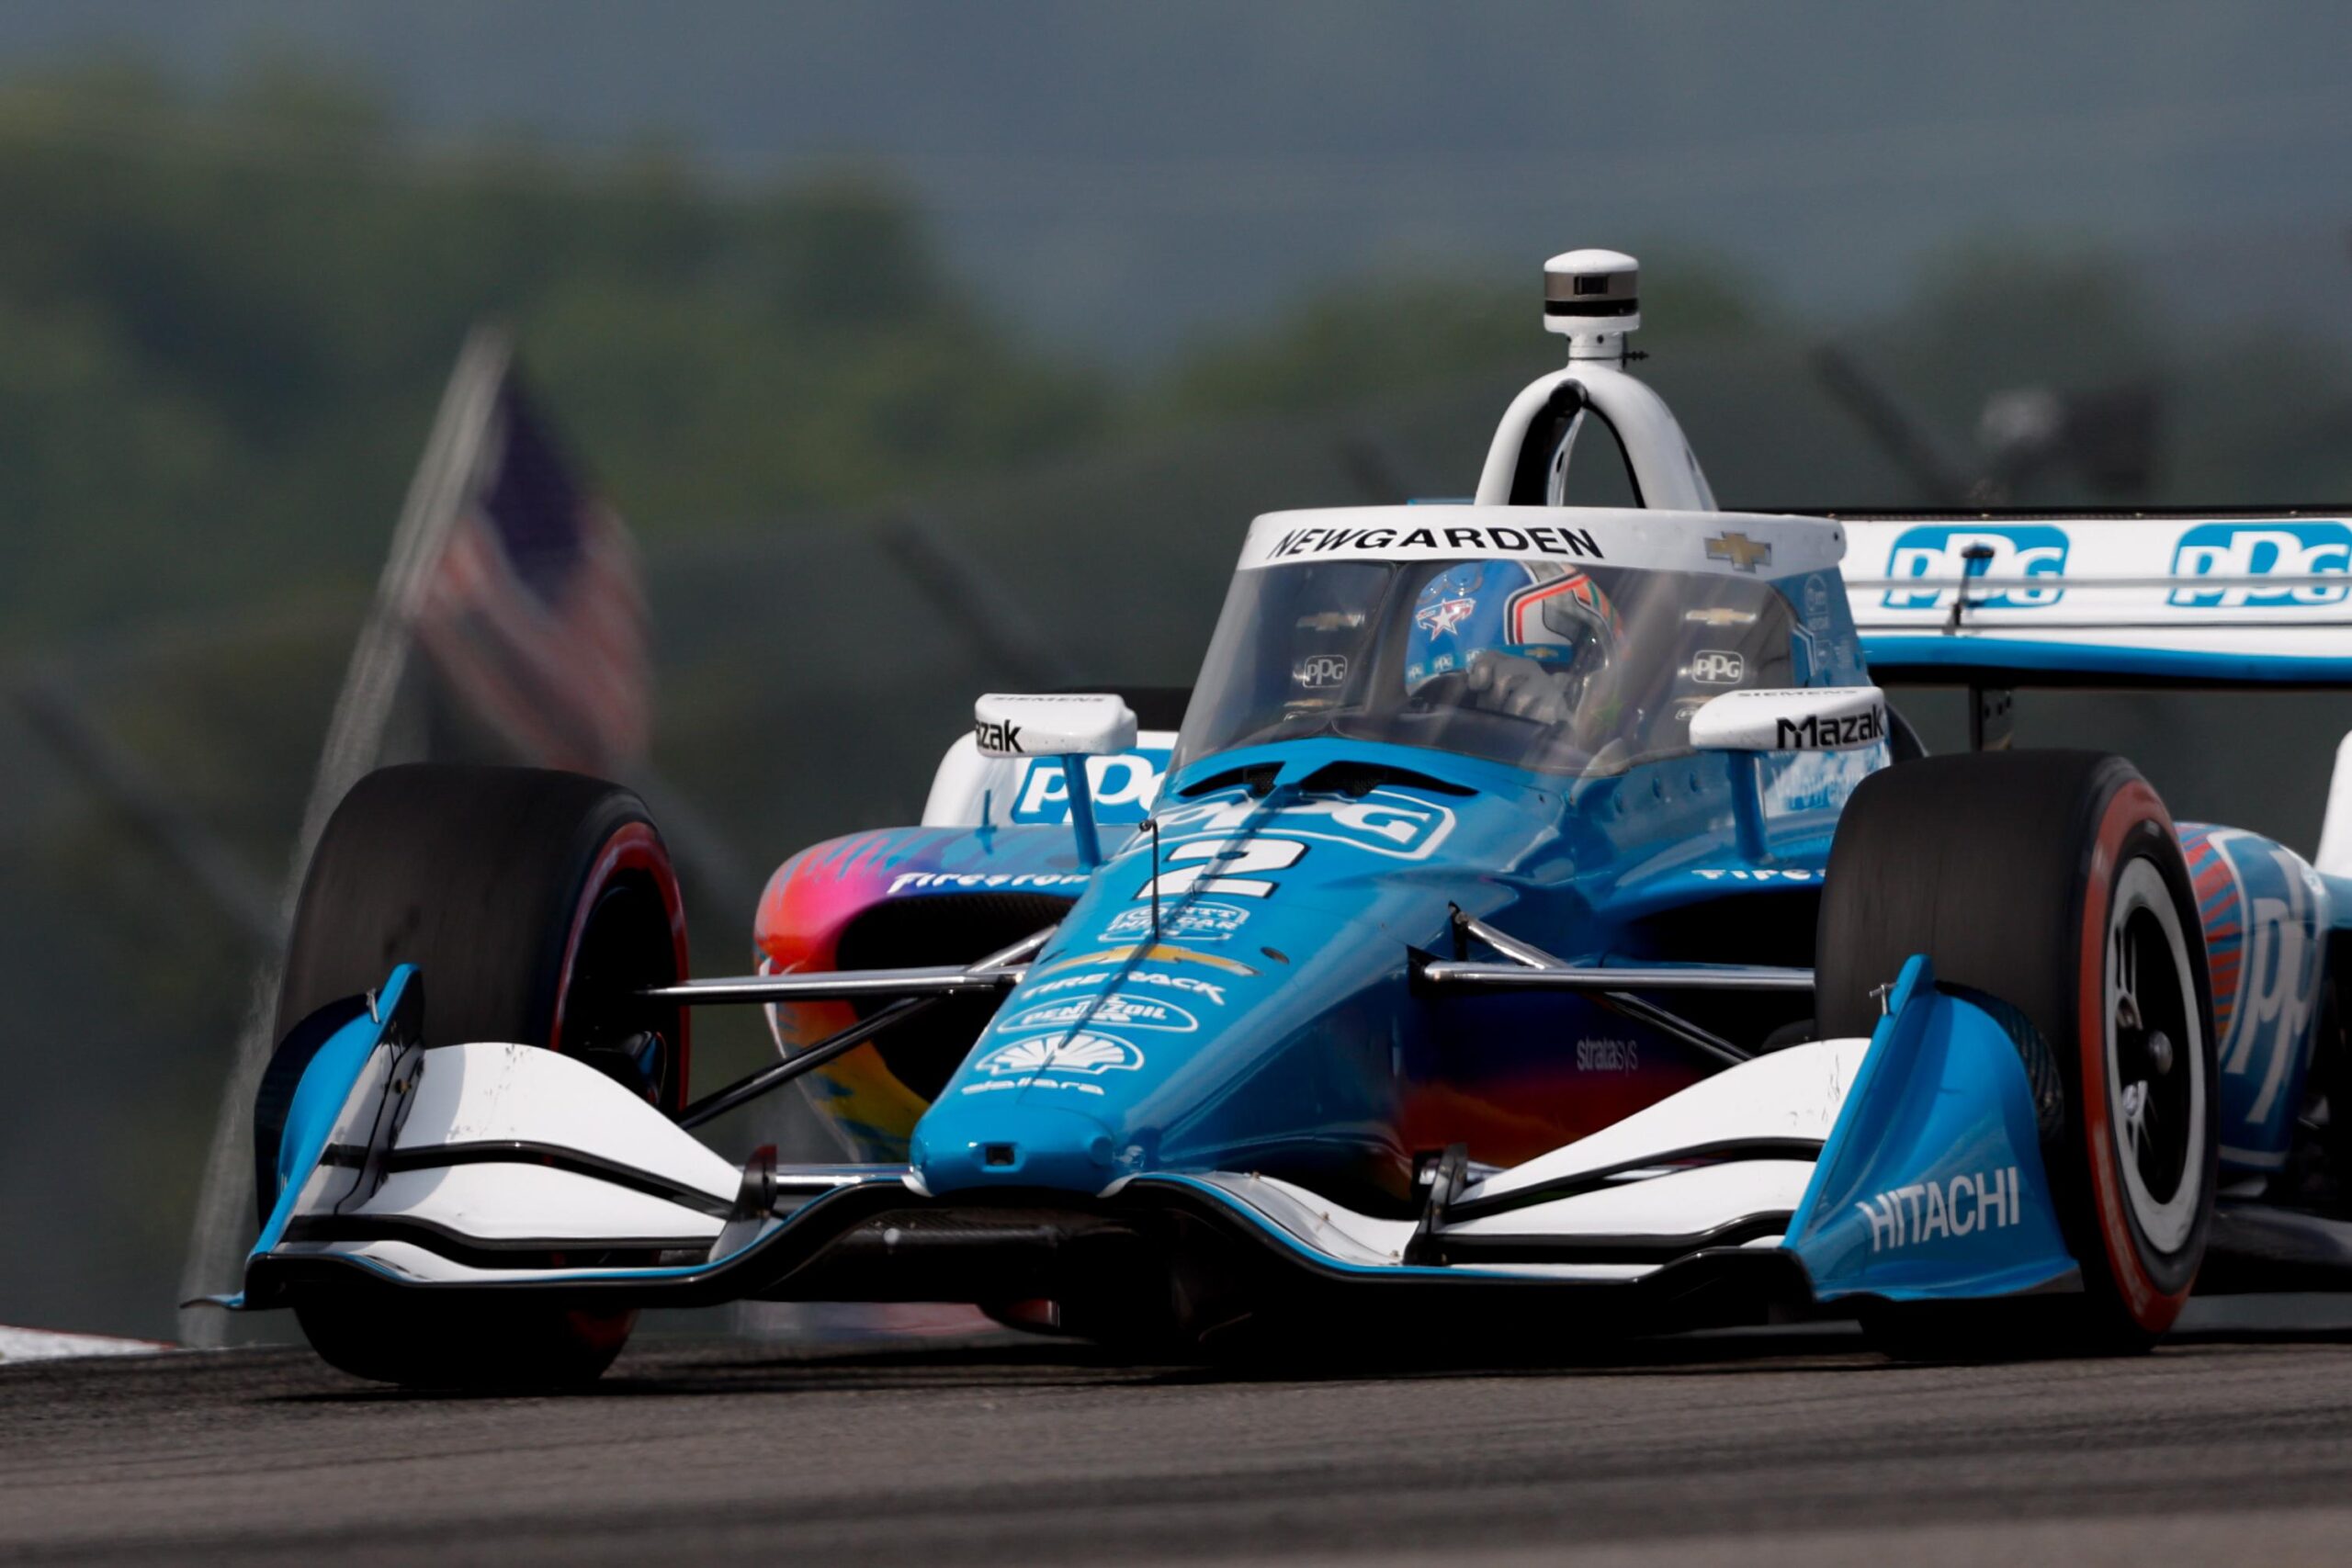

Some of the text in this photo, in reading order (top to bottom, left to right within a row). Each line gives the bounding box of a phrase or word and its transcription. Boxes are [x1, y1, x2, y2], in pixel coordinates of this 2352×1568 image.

[1266, 526, 1604, 559] NEWGARDEN
[1888, 533, 2064, 606] PPG
[2171, 530, 2352, 605] PPG
[1306, 659, 1344, 685] PPG
[1696, 654, 1741, 681] PPG
[1776, 704, 1884, 750] Mazak
[886, 873, 1092, 895] Fireston
[1131, 837, 1312, 901] 2
[1020, 972, 1112, 1000] TIRE
[1576, 1035, 1639, 1078] stratasys
[961, 1077, 1105, 1096] dallara
[1854, 1166, 2020, 1253] HITACHI
